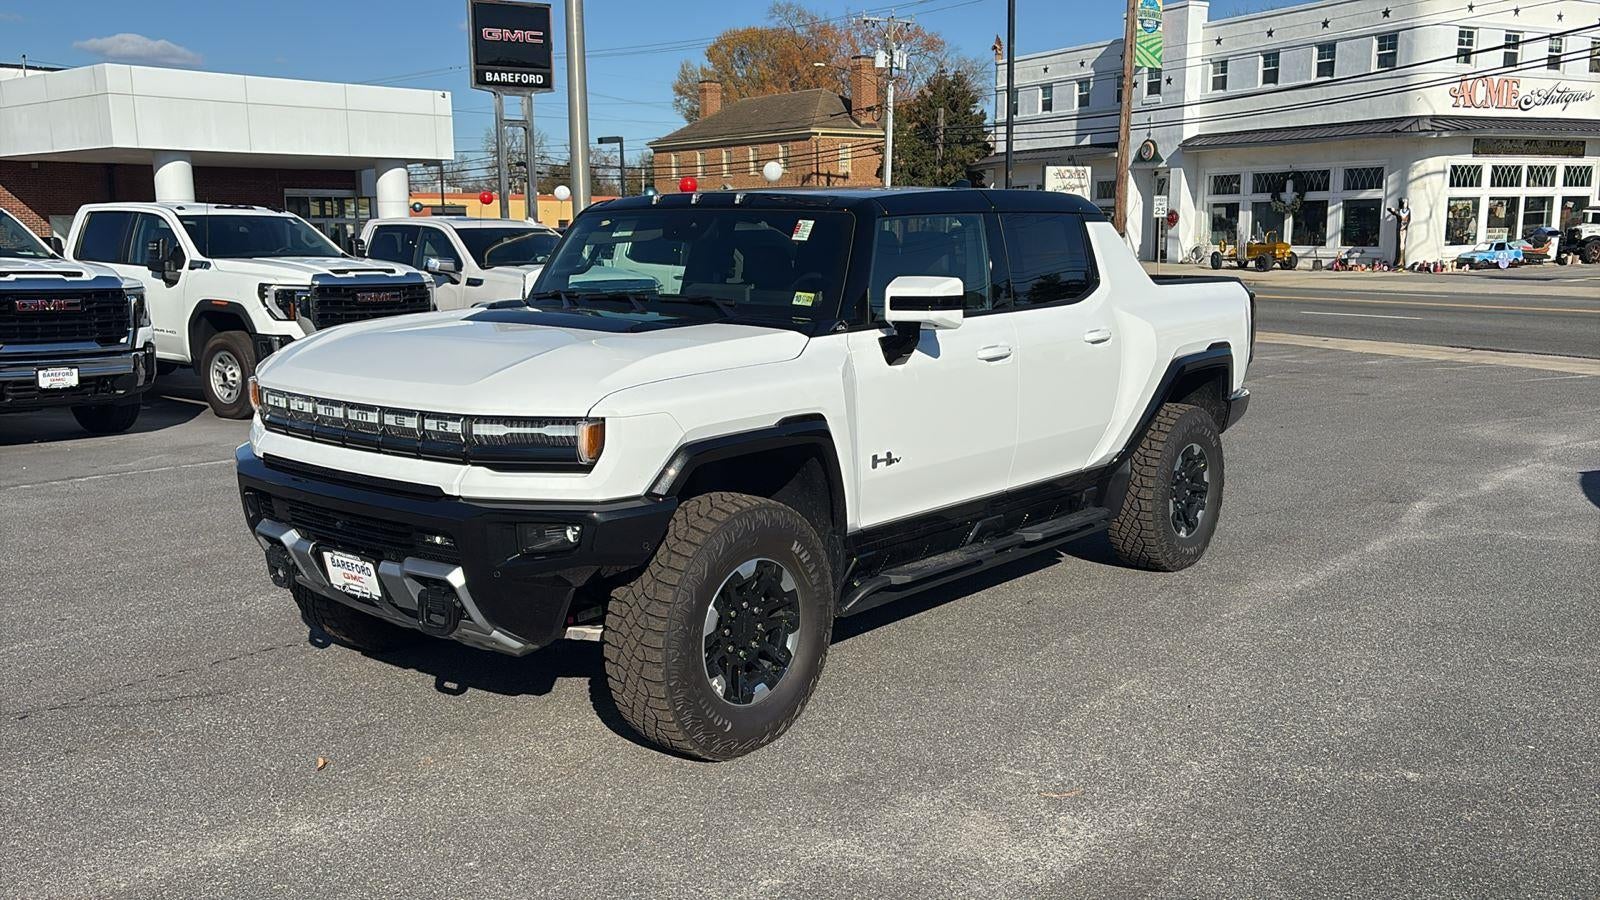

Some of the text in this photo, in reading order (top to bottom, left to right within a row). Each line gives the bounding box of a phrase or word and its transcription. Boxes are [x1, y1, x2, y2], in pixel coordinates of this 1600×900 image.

[482, 27, 544, 44] GMC
[485, 72, 544, 84] BAREFORD
[1449, 75, 1595, 112] ACME Antiques
[1155, 207, 1165, 215] 25
[357, 291, 400, 302] GMC
[15, 299, 81, 311] GMC
[273, 397, 449, 431] HUMMER
[331, 557, 372, 577] BAREFORD
[343, 572, 365, 584] GMC
